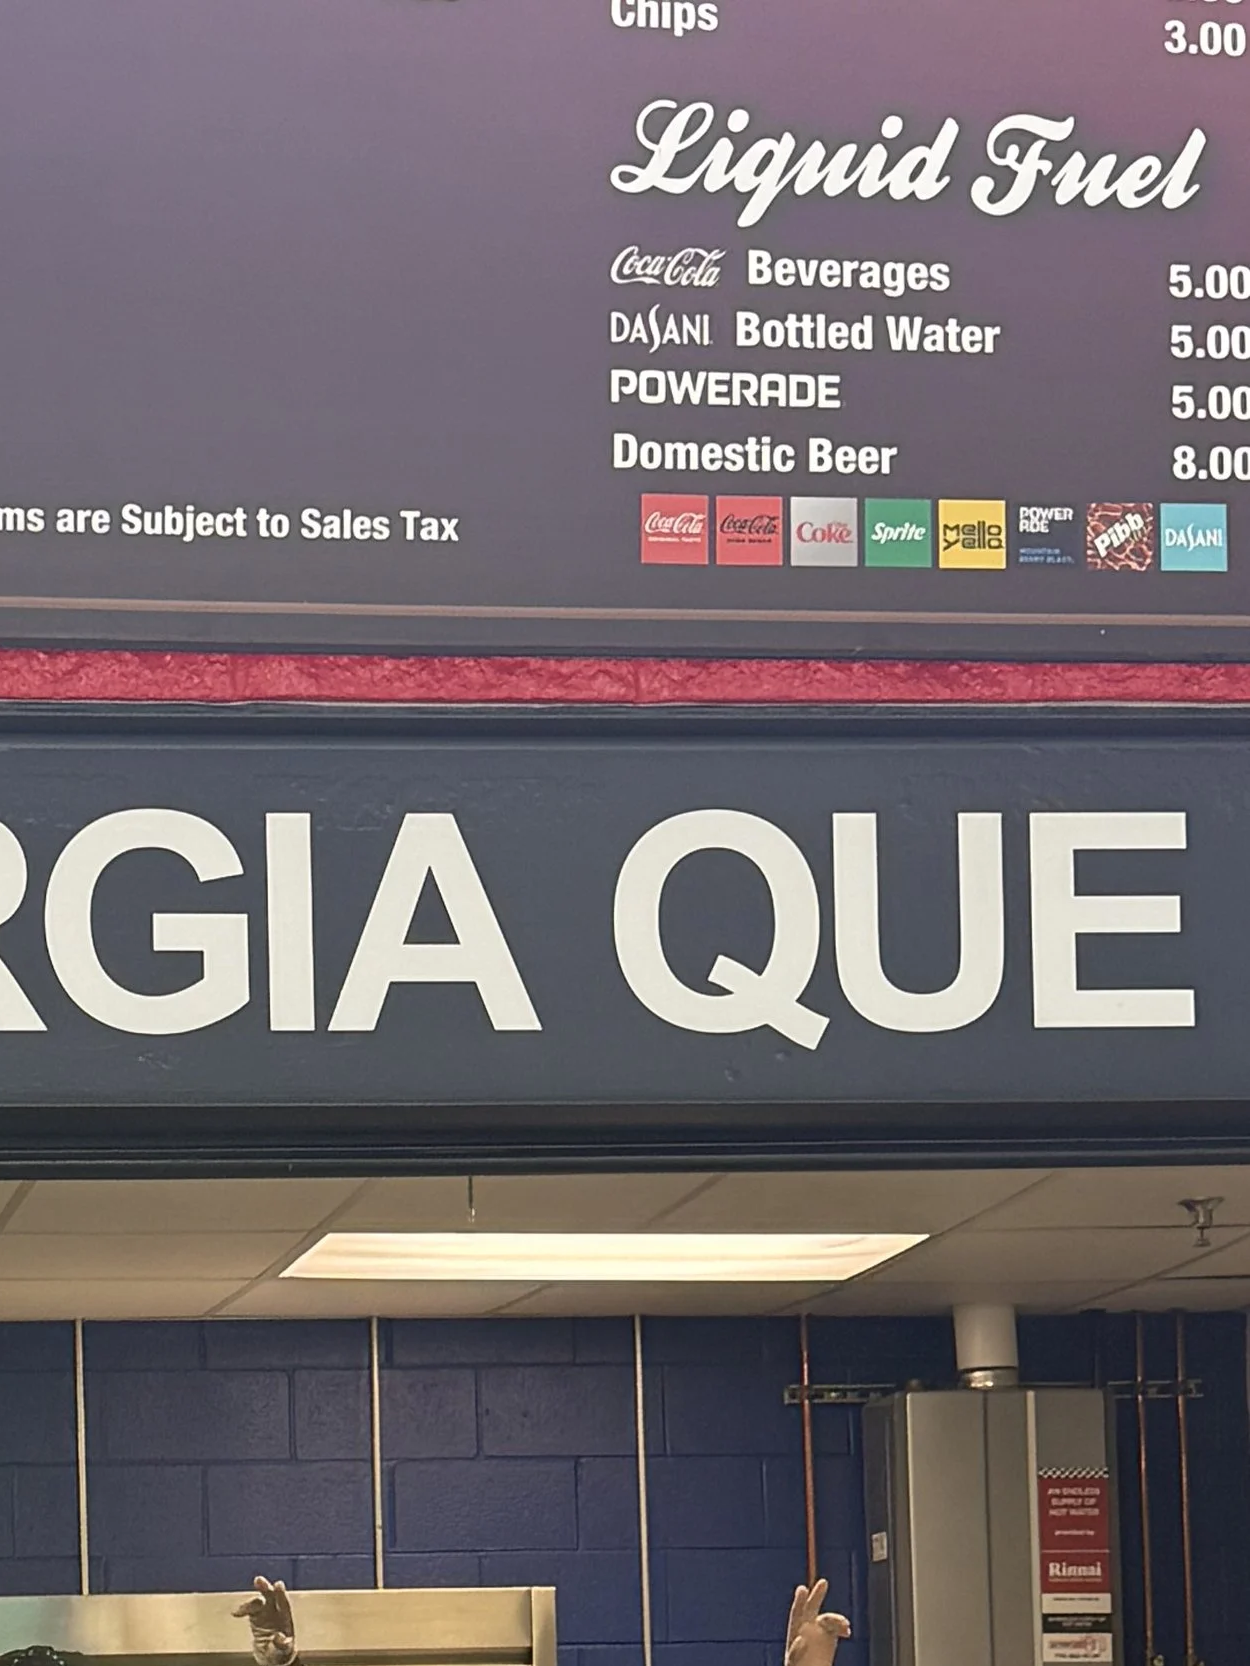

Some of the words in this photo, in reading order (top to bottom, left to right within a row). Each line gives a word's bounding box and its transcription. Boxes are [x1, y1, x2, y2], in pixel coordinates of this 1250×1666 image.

[611, 0, 719, 37] Chips
[1164, 19, 1247, 57] 3.00
[610, 99, 959, 227] Liquid
[971, 114, 1207, 216] Fuel
[611, 245, 727, 287] Coca-Cola
[747, 249, 950, 297] Beverages
[1168, 264, 1250, 299] 5.00
[610, 304, 713, 353] DASANI
[736, 311, 873, 351] Bottled
[886, 316, 1001, 354] Water
[1170, 324, 1250, 359] 5.00
[611, 369, 841, 408] POWERADE
[1171, 385, 1250, 419] 5.00
[612, 433, 795, 473] Domestic
[807, 437, 897, 475] Beer
[1173, 445, 1250, 480] 8.00
[56, 508, 111, 533] are
[121, 503, 248, 542] Subject
[256, 508, 290, 538] to
[300, 508, 390, 540] Sales
[400, 510, 459, 541] Tax
[871, 521, 927, 544] Sprite
[1019, 507, 1074, 521] POWER
[1093, 512, 1145, 559] Pibb
[1165, 522, 1223, 552] DASANI
[613, 809, 1197, 1051] QUE
[1049, 1562, 1102, 1577] Rinnai
